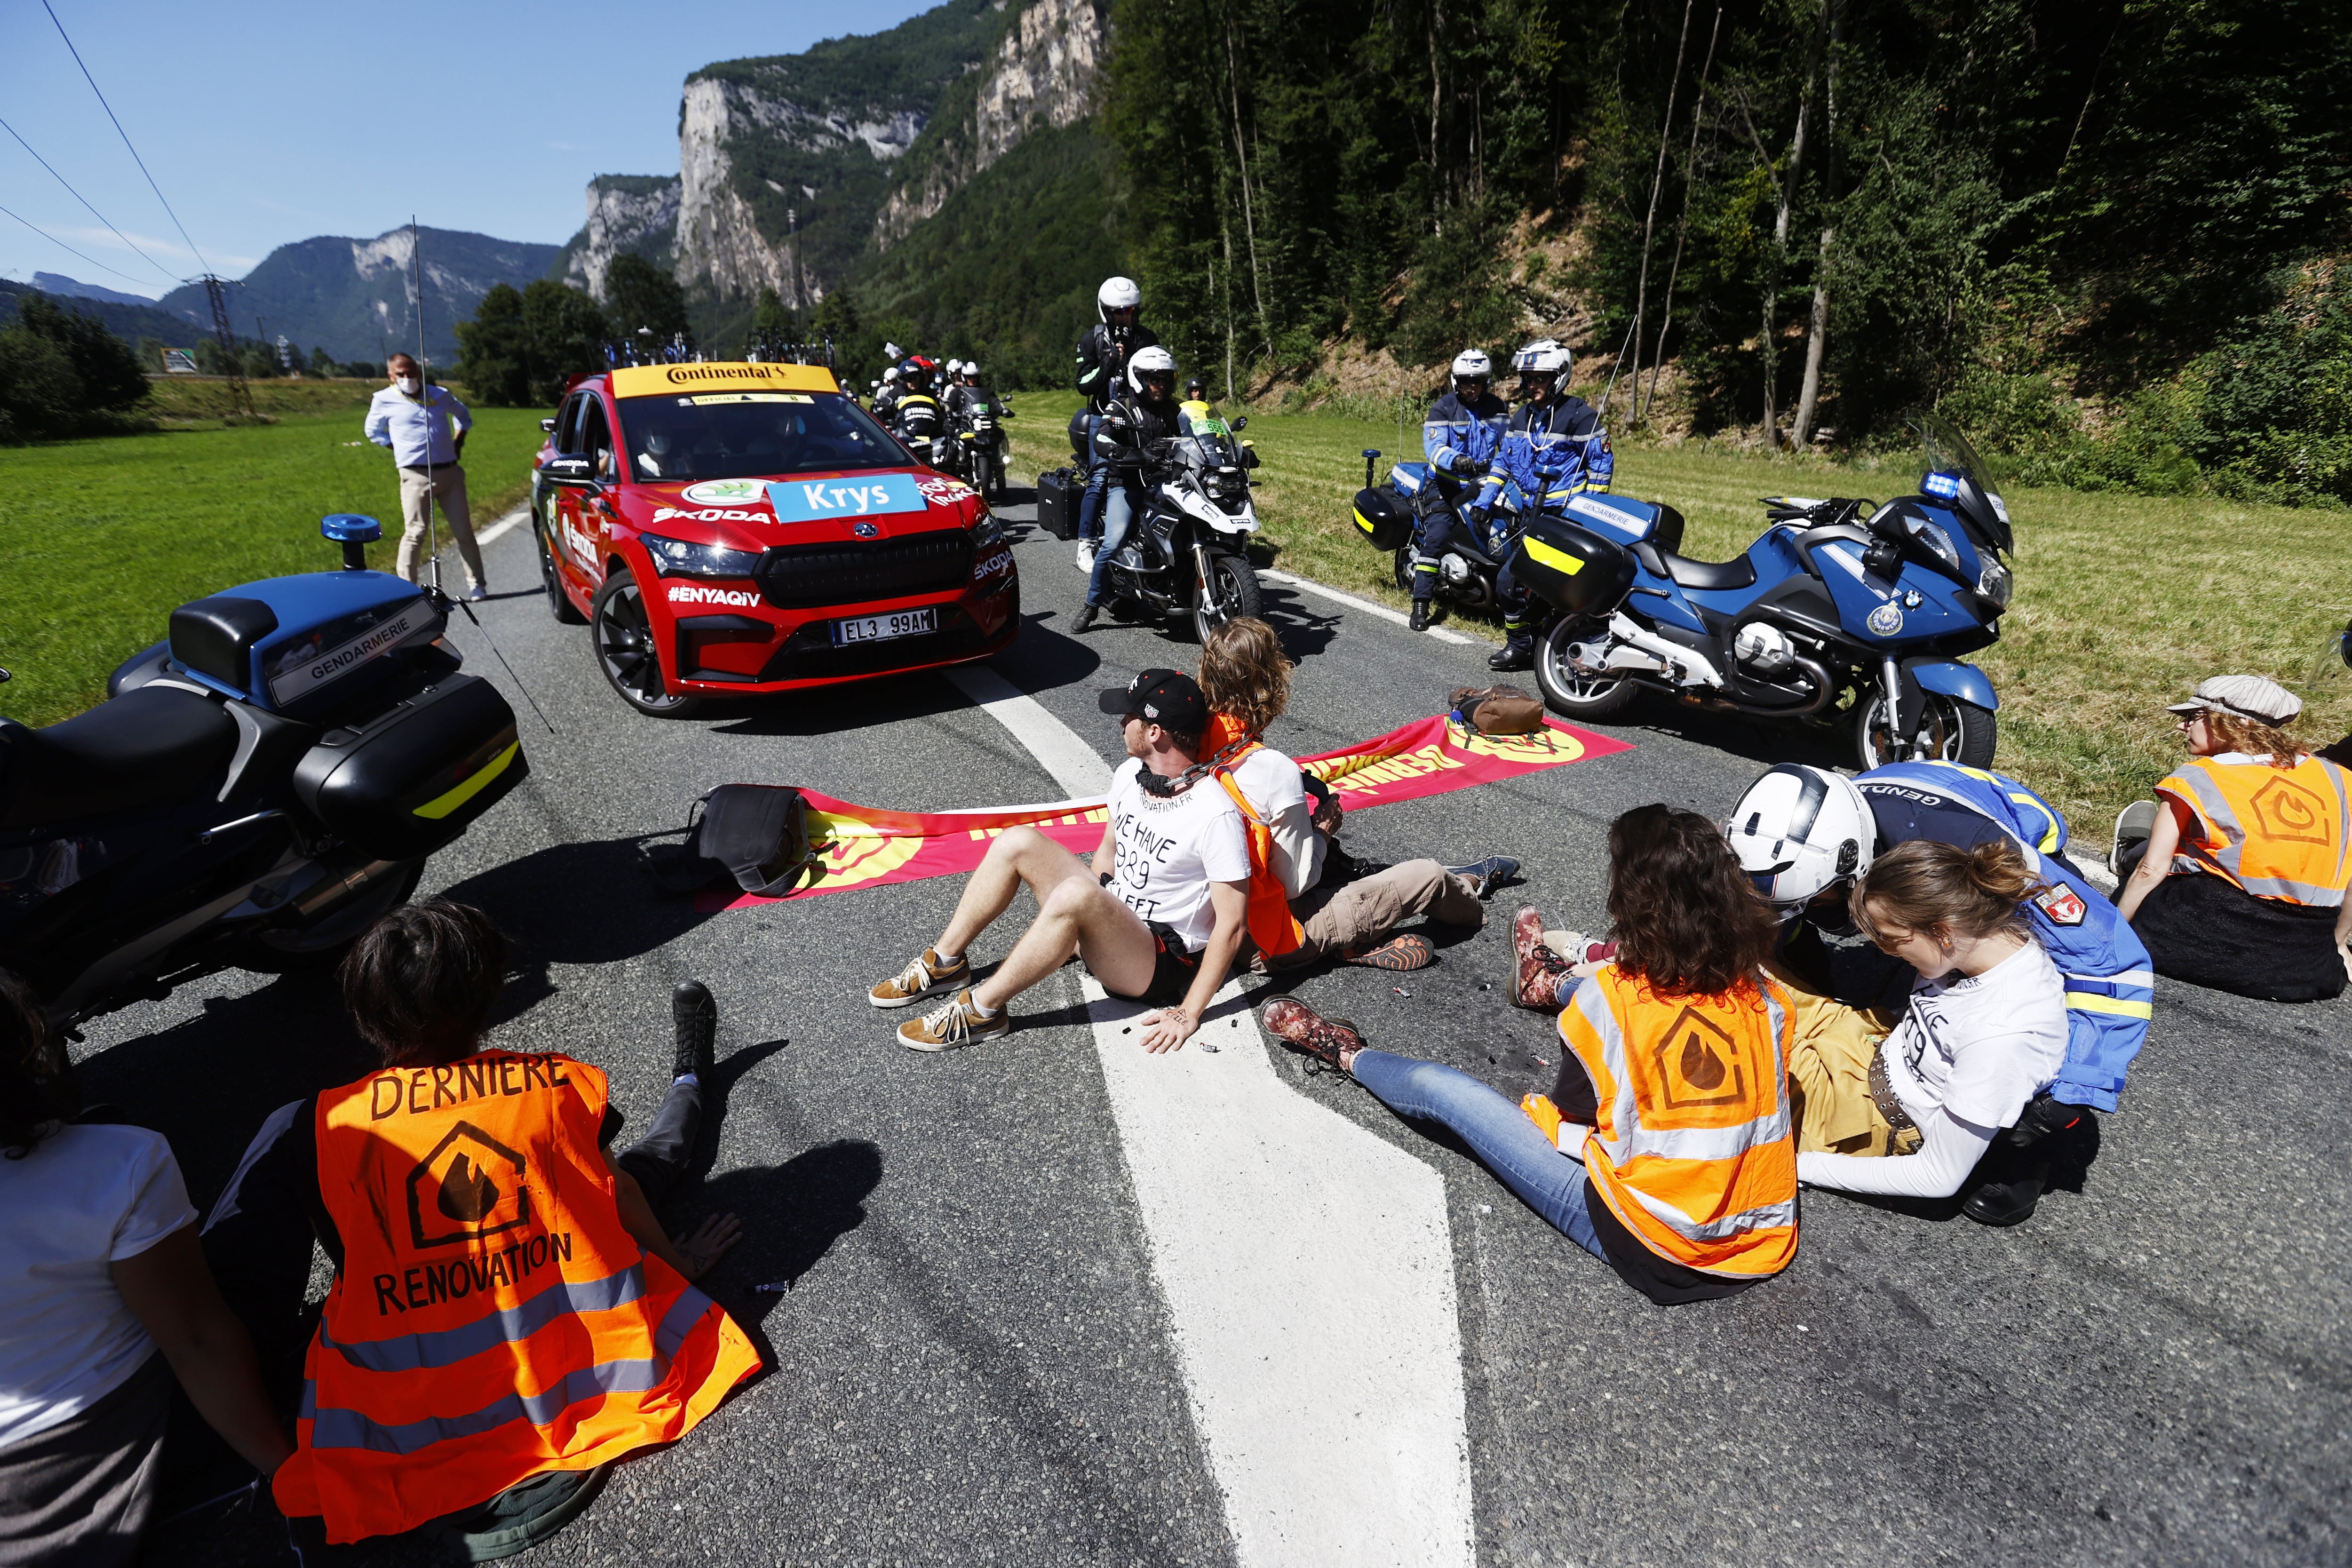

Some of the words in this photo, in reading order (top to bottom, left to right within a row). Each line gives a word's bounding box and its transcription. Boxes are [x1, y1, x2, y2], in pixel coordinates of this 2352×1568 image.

[666, 366, 772, 384] Continental
[1208, 424, 1224, 433] 555
[803, 484, 890, 514] Krys
[1583, 503, 1630, 525] GENDARMERIE
[845, 620, 877, 641] EL3
[890, 611, 930, 634] 99AM
[311, 617, 410, 679] GENDARMERIE
[1147, 704, 1158, 714] TAG
[1857, 785, 1940, 806] GENDA
[1115, 801, 1135, 838] WE
[1133, 821, 1177, 864] HAVE
[1116, 841, 1150, 890] 989
[1166, 1011, 1190, 1026] COLLE
[371, 1052, 570, 1121] DERNIERE
[373, 1231, 572, 1316] RENOVATION
